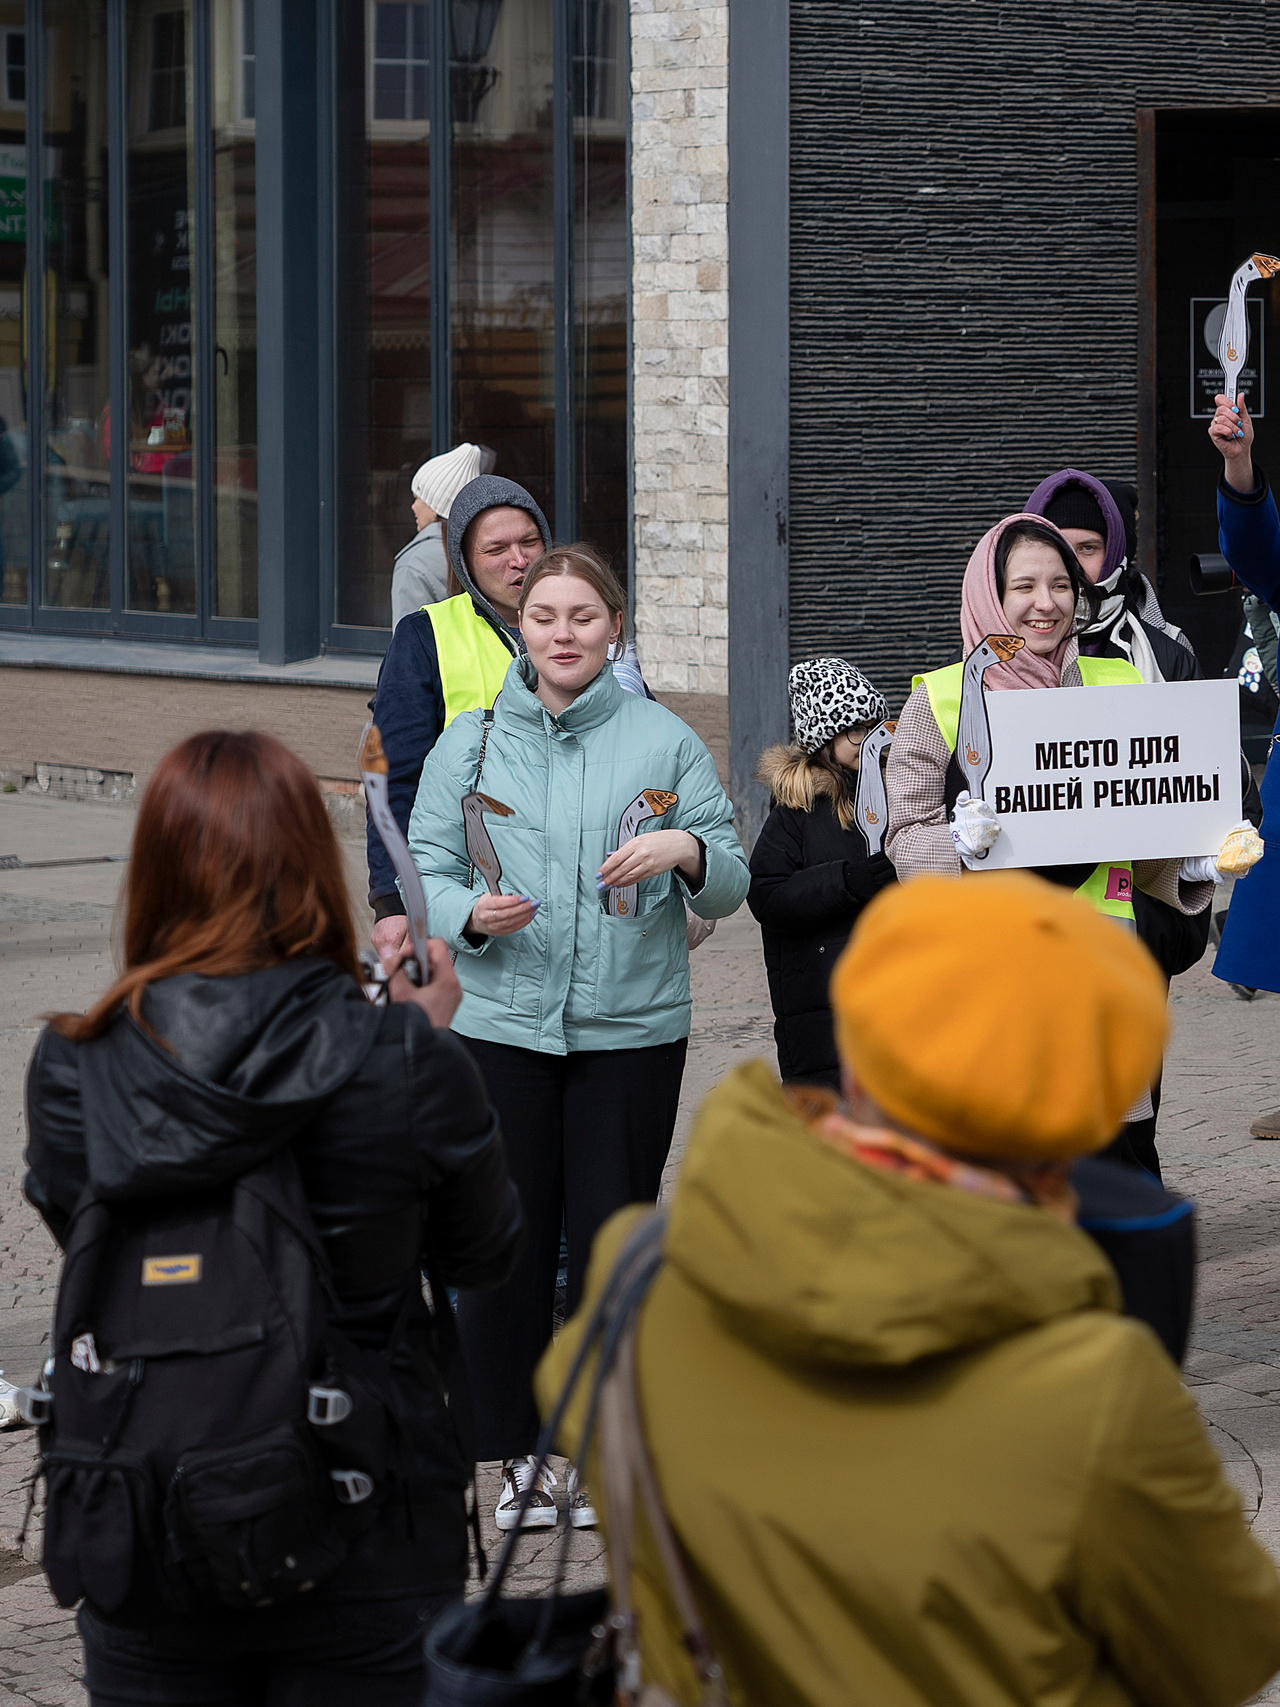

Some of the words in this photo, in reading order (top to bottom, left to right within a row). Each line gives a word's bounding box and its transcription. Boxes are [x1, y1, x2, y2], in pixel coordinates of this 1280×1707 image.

[1035, 738, 1119, 771] МЕСТО
[1128, 735, 1180, 770] ДЛЯ
[995, 776, 1083, 815] ВАШЕЙ
[1093, 773, 1220, 809] РЕКЛАМЫ
